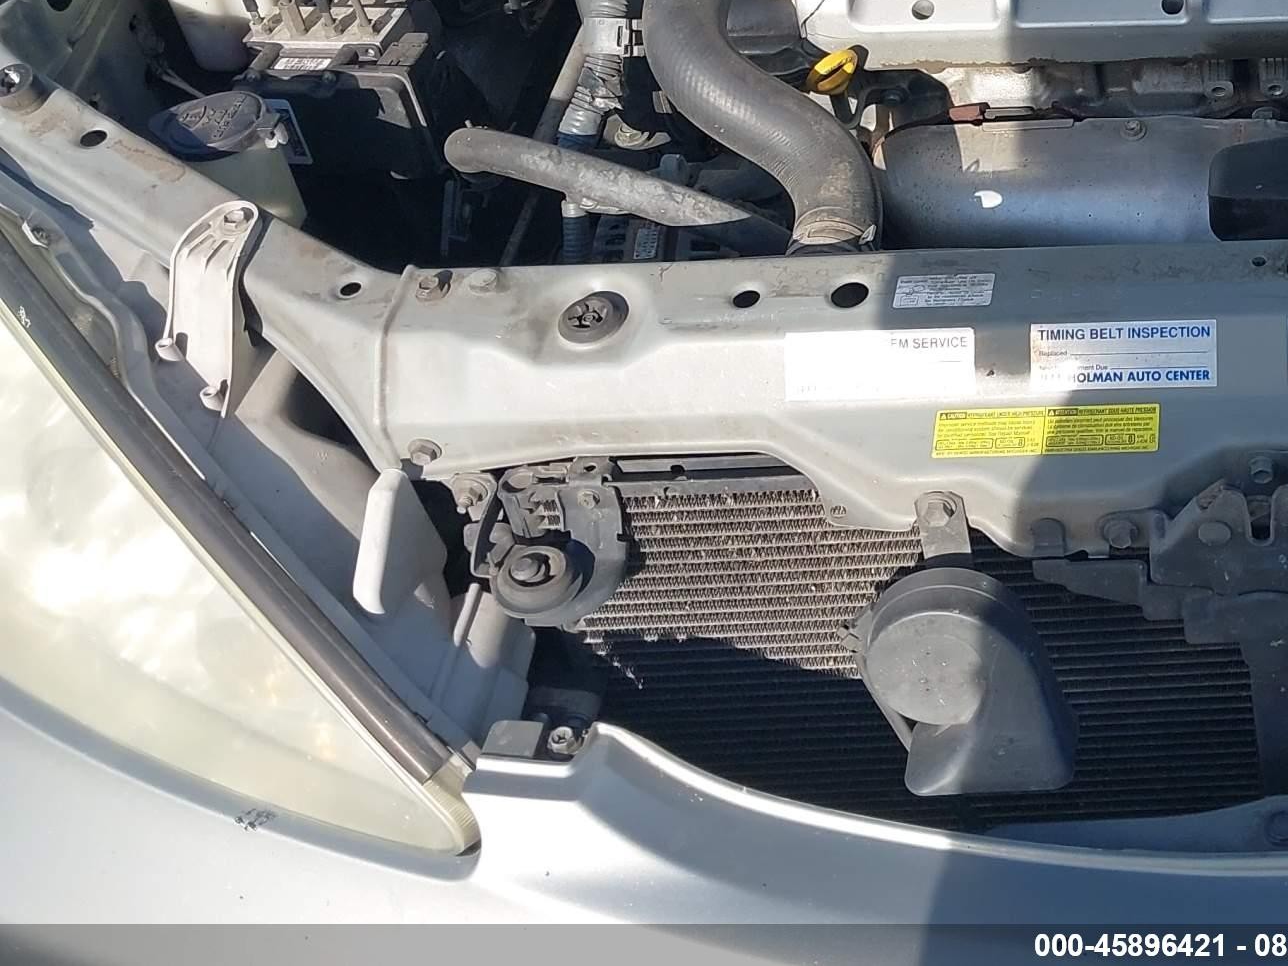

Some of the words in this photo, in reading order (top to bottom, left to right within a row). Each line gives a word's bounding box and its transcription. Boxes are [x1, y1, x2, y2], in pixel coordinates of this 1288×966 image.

[1038, 328, 1085, 341] TIMING
[1090, 328, 1124, 340] BELT
[1127, 326, 1211, 339] INSPECTION
[912, 336, 968, 349] SERVICE
[1127, 371, 1162, 382] AUTO
[1165, 370, 1210, 381] CENTER
